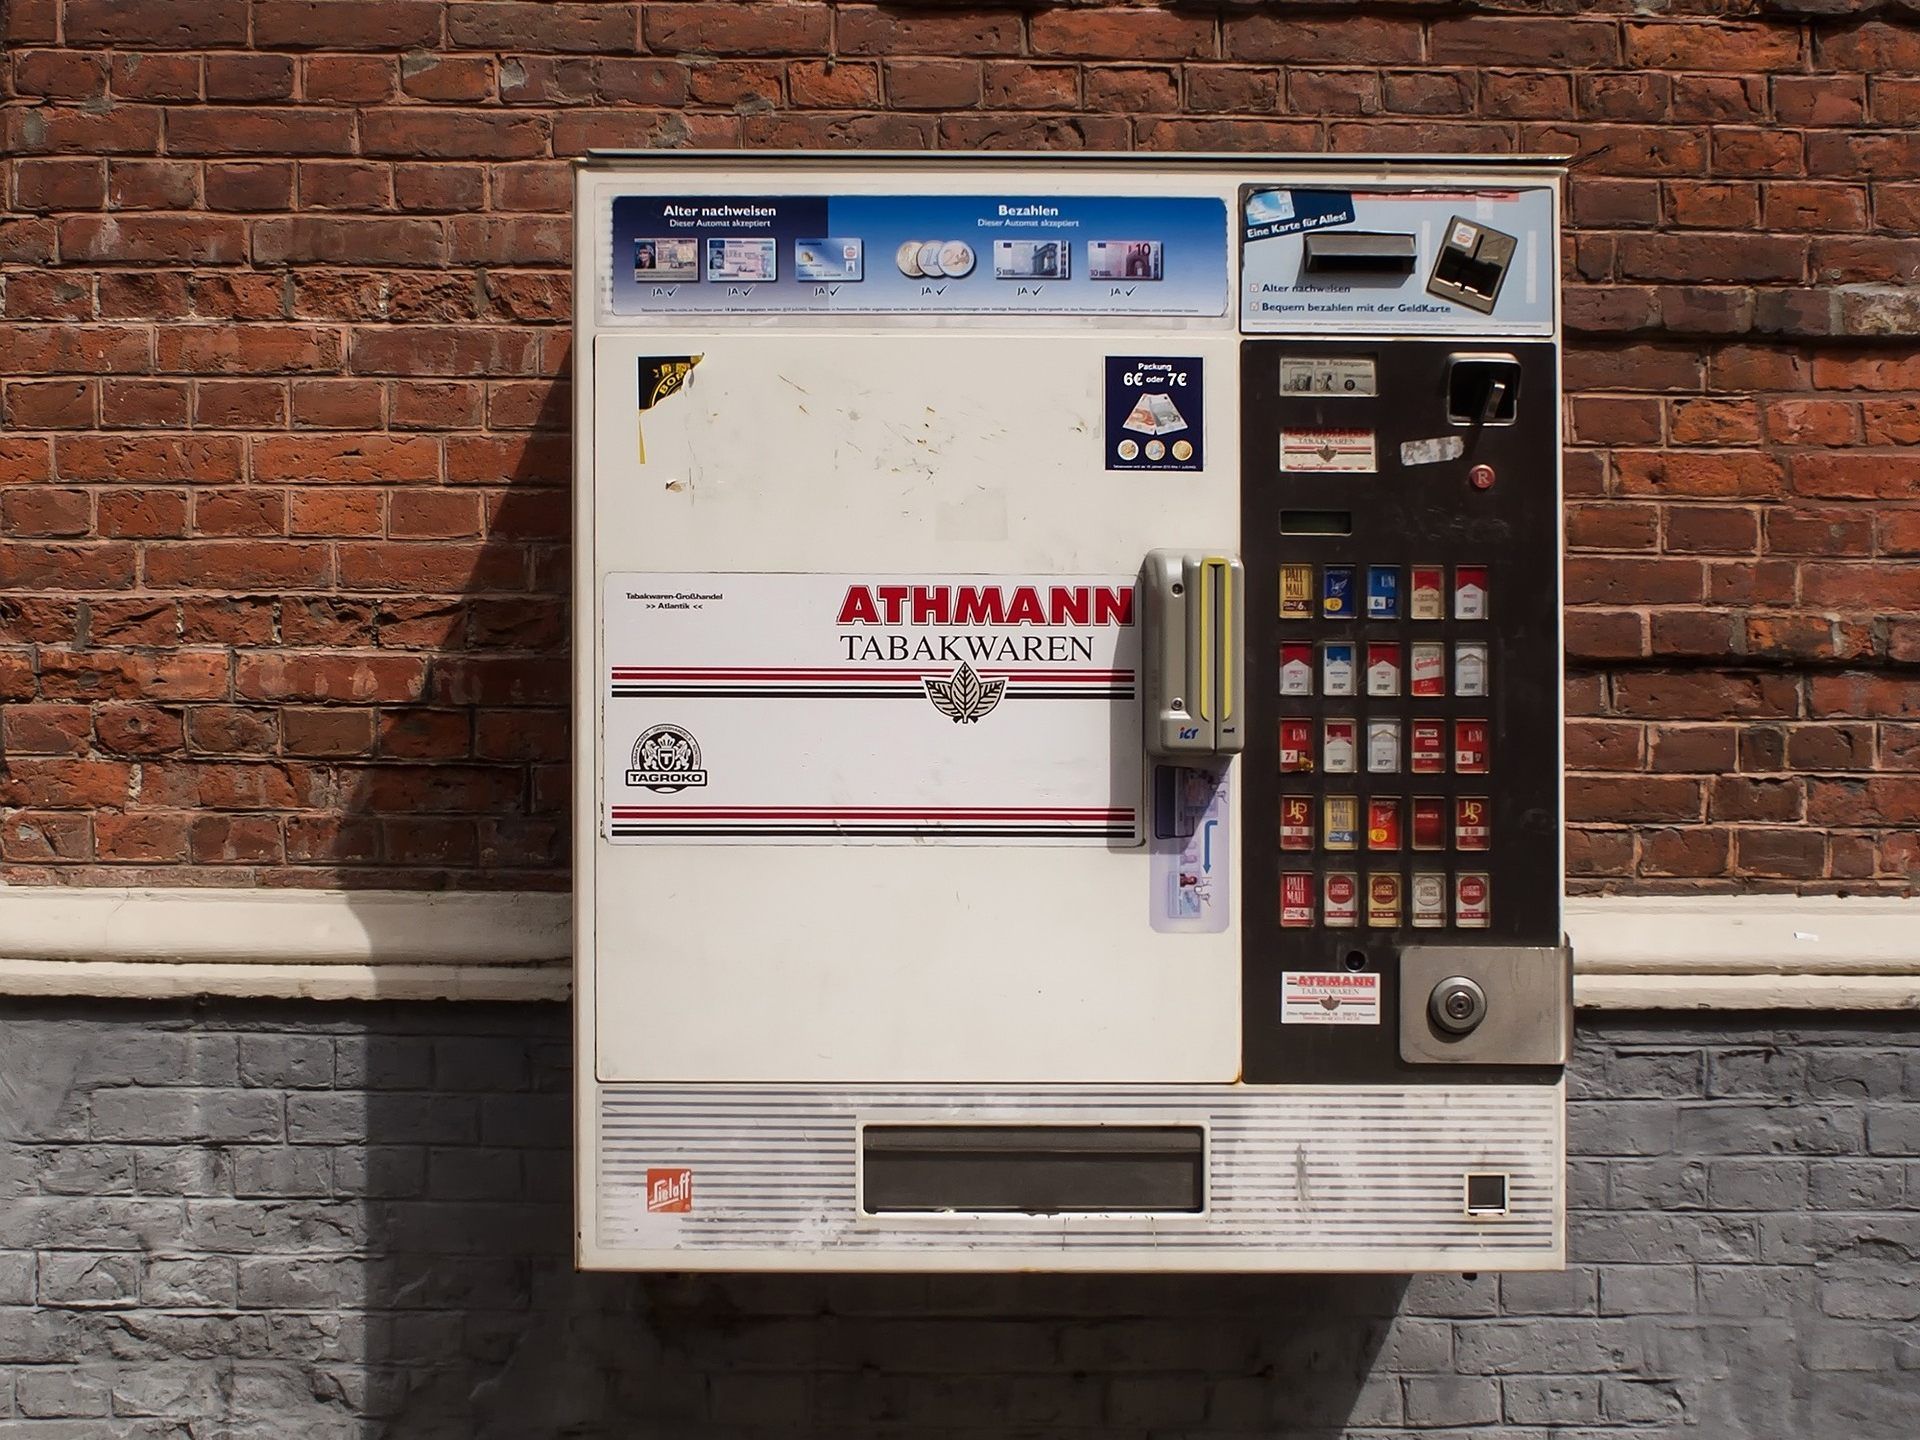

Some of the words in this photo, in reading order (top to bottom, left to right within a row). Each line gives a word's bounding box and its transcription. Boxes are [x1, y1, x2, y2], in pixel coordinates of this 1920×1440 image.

[663, 205, 699, 216] Alter
[702, 205, 776, 216] nachweisen
[998, 204, 1059, 216] Bezahlen
[669, 219, 695, 227] Dieser
[696, 219, 730, 227] Automat
[732, 219, 771, 229] akzeptiert
[977, 219, 1003, 227] Dieser
[1004, 219, 1038, 227] Automat
[1040, 219, 1079, 228] akzeptiert
[1246, 228, 1269, 238] Eine
[1271, 223, 1300, 234] Karte
[1302, 218, 1317, 227] für
[1319, 211, 1347, 225] Alles!
[651, 287, 663, 297] JA
[727, 287, 739, 297] JA
[814, 287, 825, 297] JA
[921, 286, 932, 296] JA
[1017, 287, 1028, 296] JA
[1110, 287, 1121, 297] JA
[1262, 284, 1288, 293] Alter
[1292, 284, 1351, 293] nachweisen
[1261, 303, 1304, 313] Bequem
[1307, 303, 1353, 312] bezahlen
[1356, 303, 1374, 312] mit
[1377, 303, 1395, 312] der
[1397, 304, 1451, 313] GeldKarte
[1138, 363, 1173, 372] Packung
[1123, 372, 1143, 386] 6€
[1167, 372, 1187, 387] 7€
[1477, 471, 1490, 484] R
[625, 592, 723, 600] Tabakwaren-Großhandel
[837, 584, 1135, 627] ATHMANN
[839, 634, 1095, 662] TABAKWAREN
[630, 773, 703, 782] TAGROKO
[1286, 876, 1304, 890] PALL
[1286, 891, 1305, 904] MALL
[1298, 976, 1376, 987] ATHMANN
